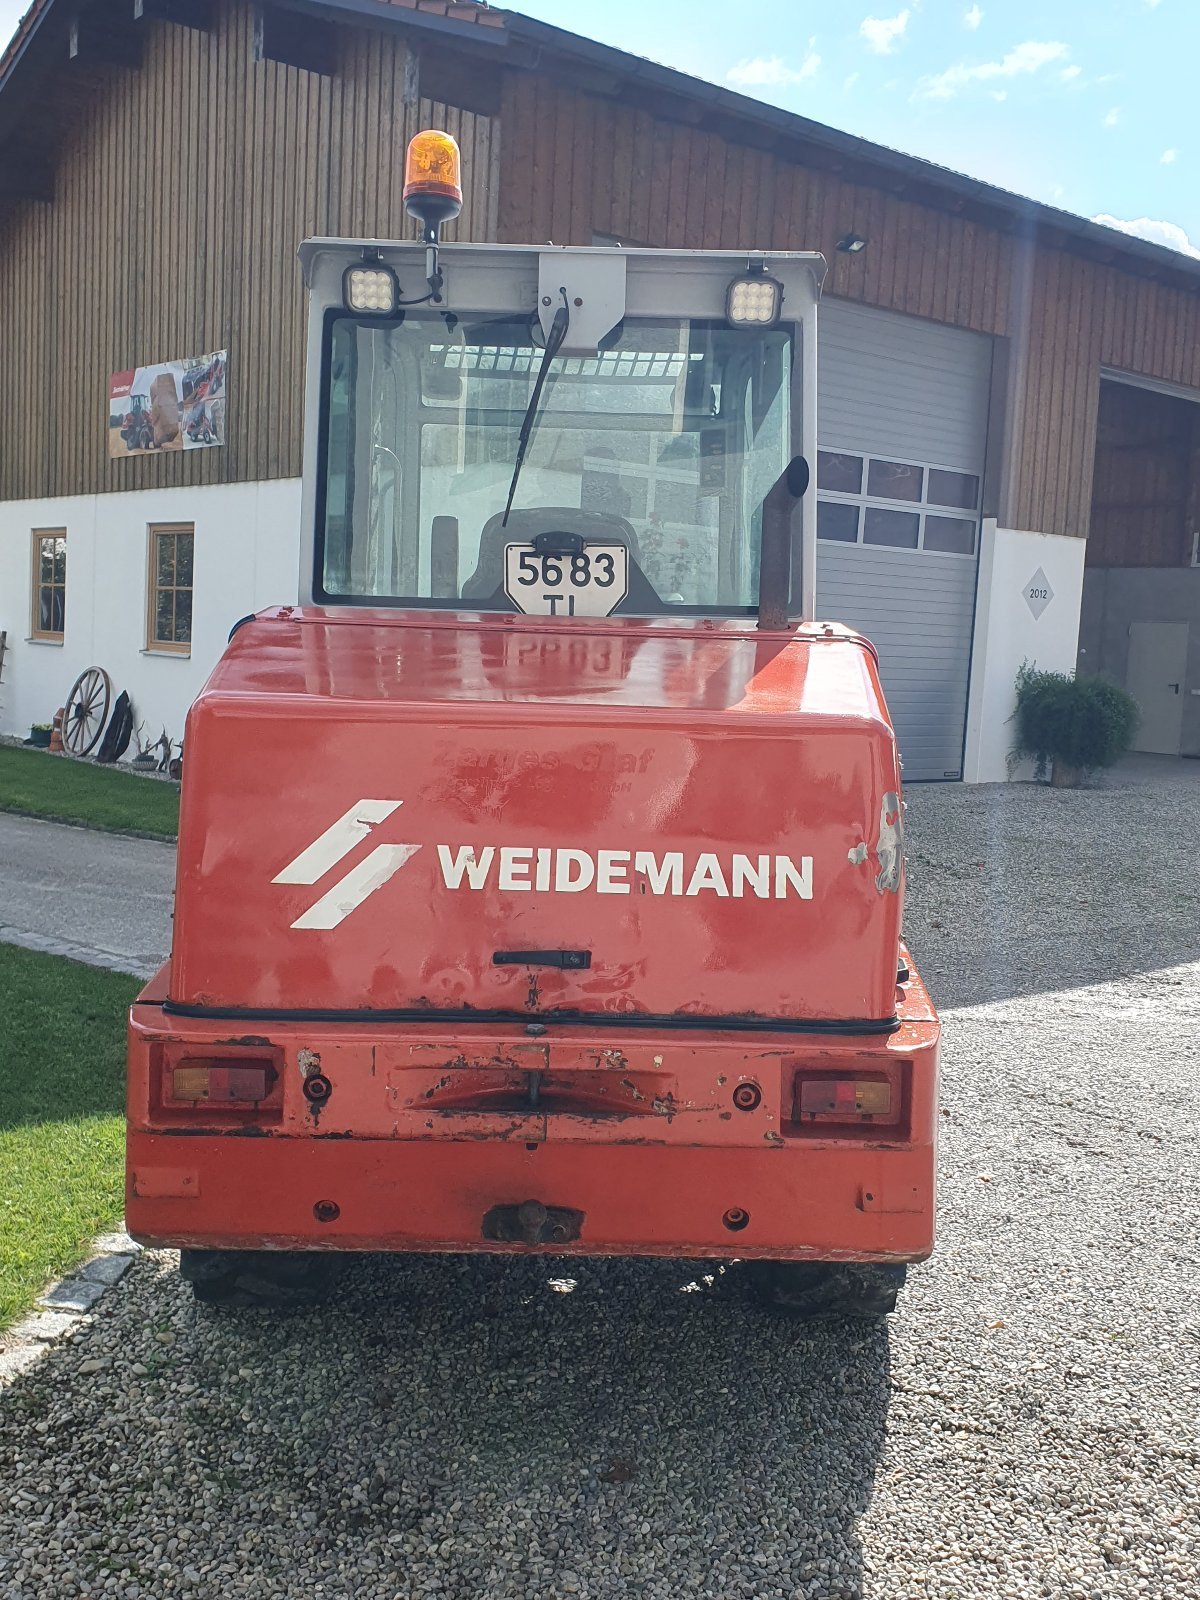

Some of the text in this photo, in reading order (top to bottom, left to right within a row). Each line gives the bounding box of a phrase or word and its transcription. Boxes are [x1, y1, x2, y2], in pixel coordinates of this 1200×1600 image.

[517, 551, 616, 588] 5683
[1029, 588, 1048, 600] 2012
[437, 844, 814, 900] WEIDEMANN
